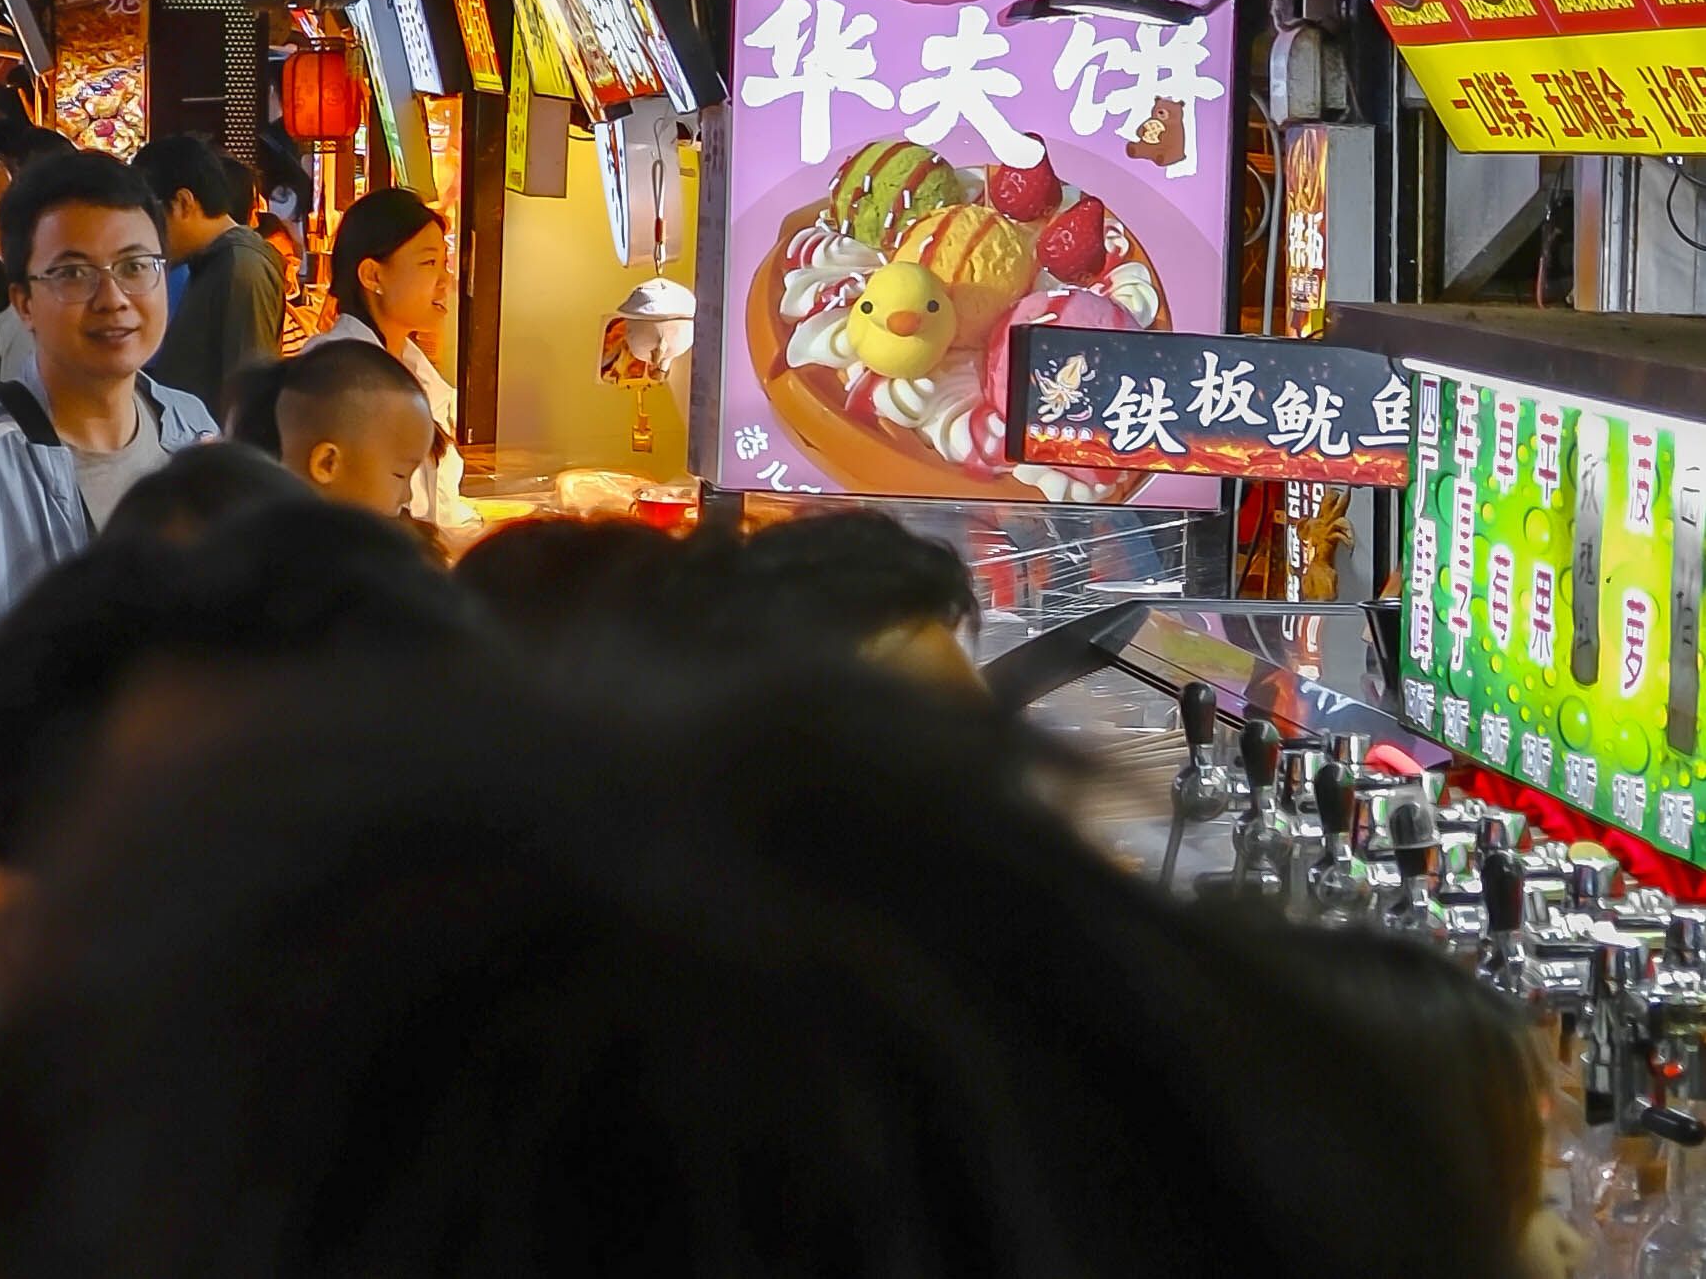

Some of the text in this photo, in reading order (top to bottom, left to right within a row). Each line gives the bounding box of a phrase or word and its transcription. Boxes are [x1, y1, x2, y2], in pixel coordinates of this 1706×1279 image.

[1451, 65, 1706, 149] 一口鲜美,五味俱全,让您
[1101, 349, 1412, 457] 铁板鱿鱼
